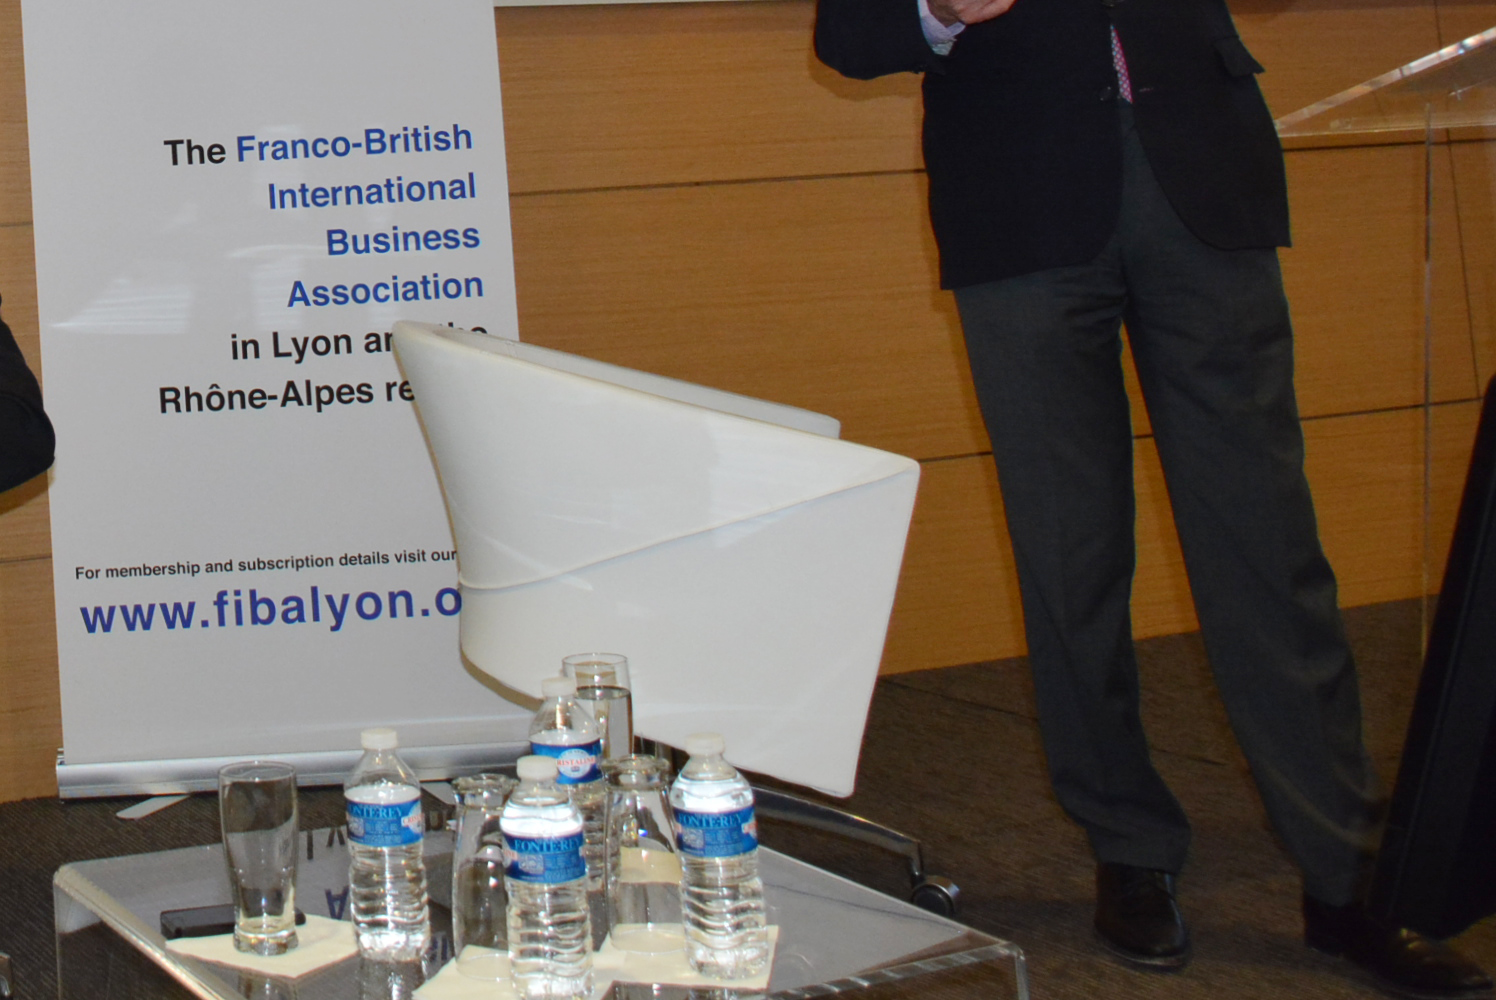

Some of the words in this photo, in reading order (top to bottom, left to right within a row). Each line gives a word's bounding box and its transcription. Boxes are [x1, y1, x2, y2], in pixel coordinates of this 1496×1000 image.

[163, 138, 227, 167] The
[236, 123, 473, 163] Franco-British
[268, 172, 477, 210] International
[326, 225, 481, 257] Business
[286, 272, 484, 308] Association
[230, 333, 260, 361] in
[271, 331, 353, 364] Lyon
[159, 378, 374, 414] Rhône-Alpes
[75, 565, 101, 581] For
[105, 561, 201, 578] membership
[204, 558, 234, 574] and
[238, 553, 335, 574] subscription
[338, 550, 391, 568] details
[394, 549, 427, 565] visit
[430, 549, 458, 564] our
[80, 585, 462, 634] www.fibalyon.o
